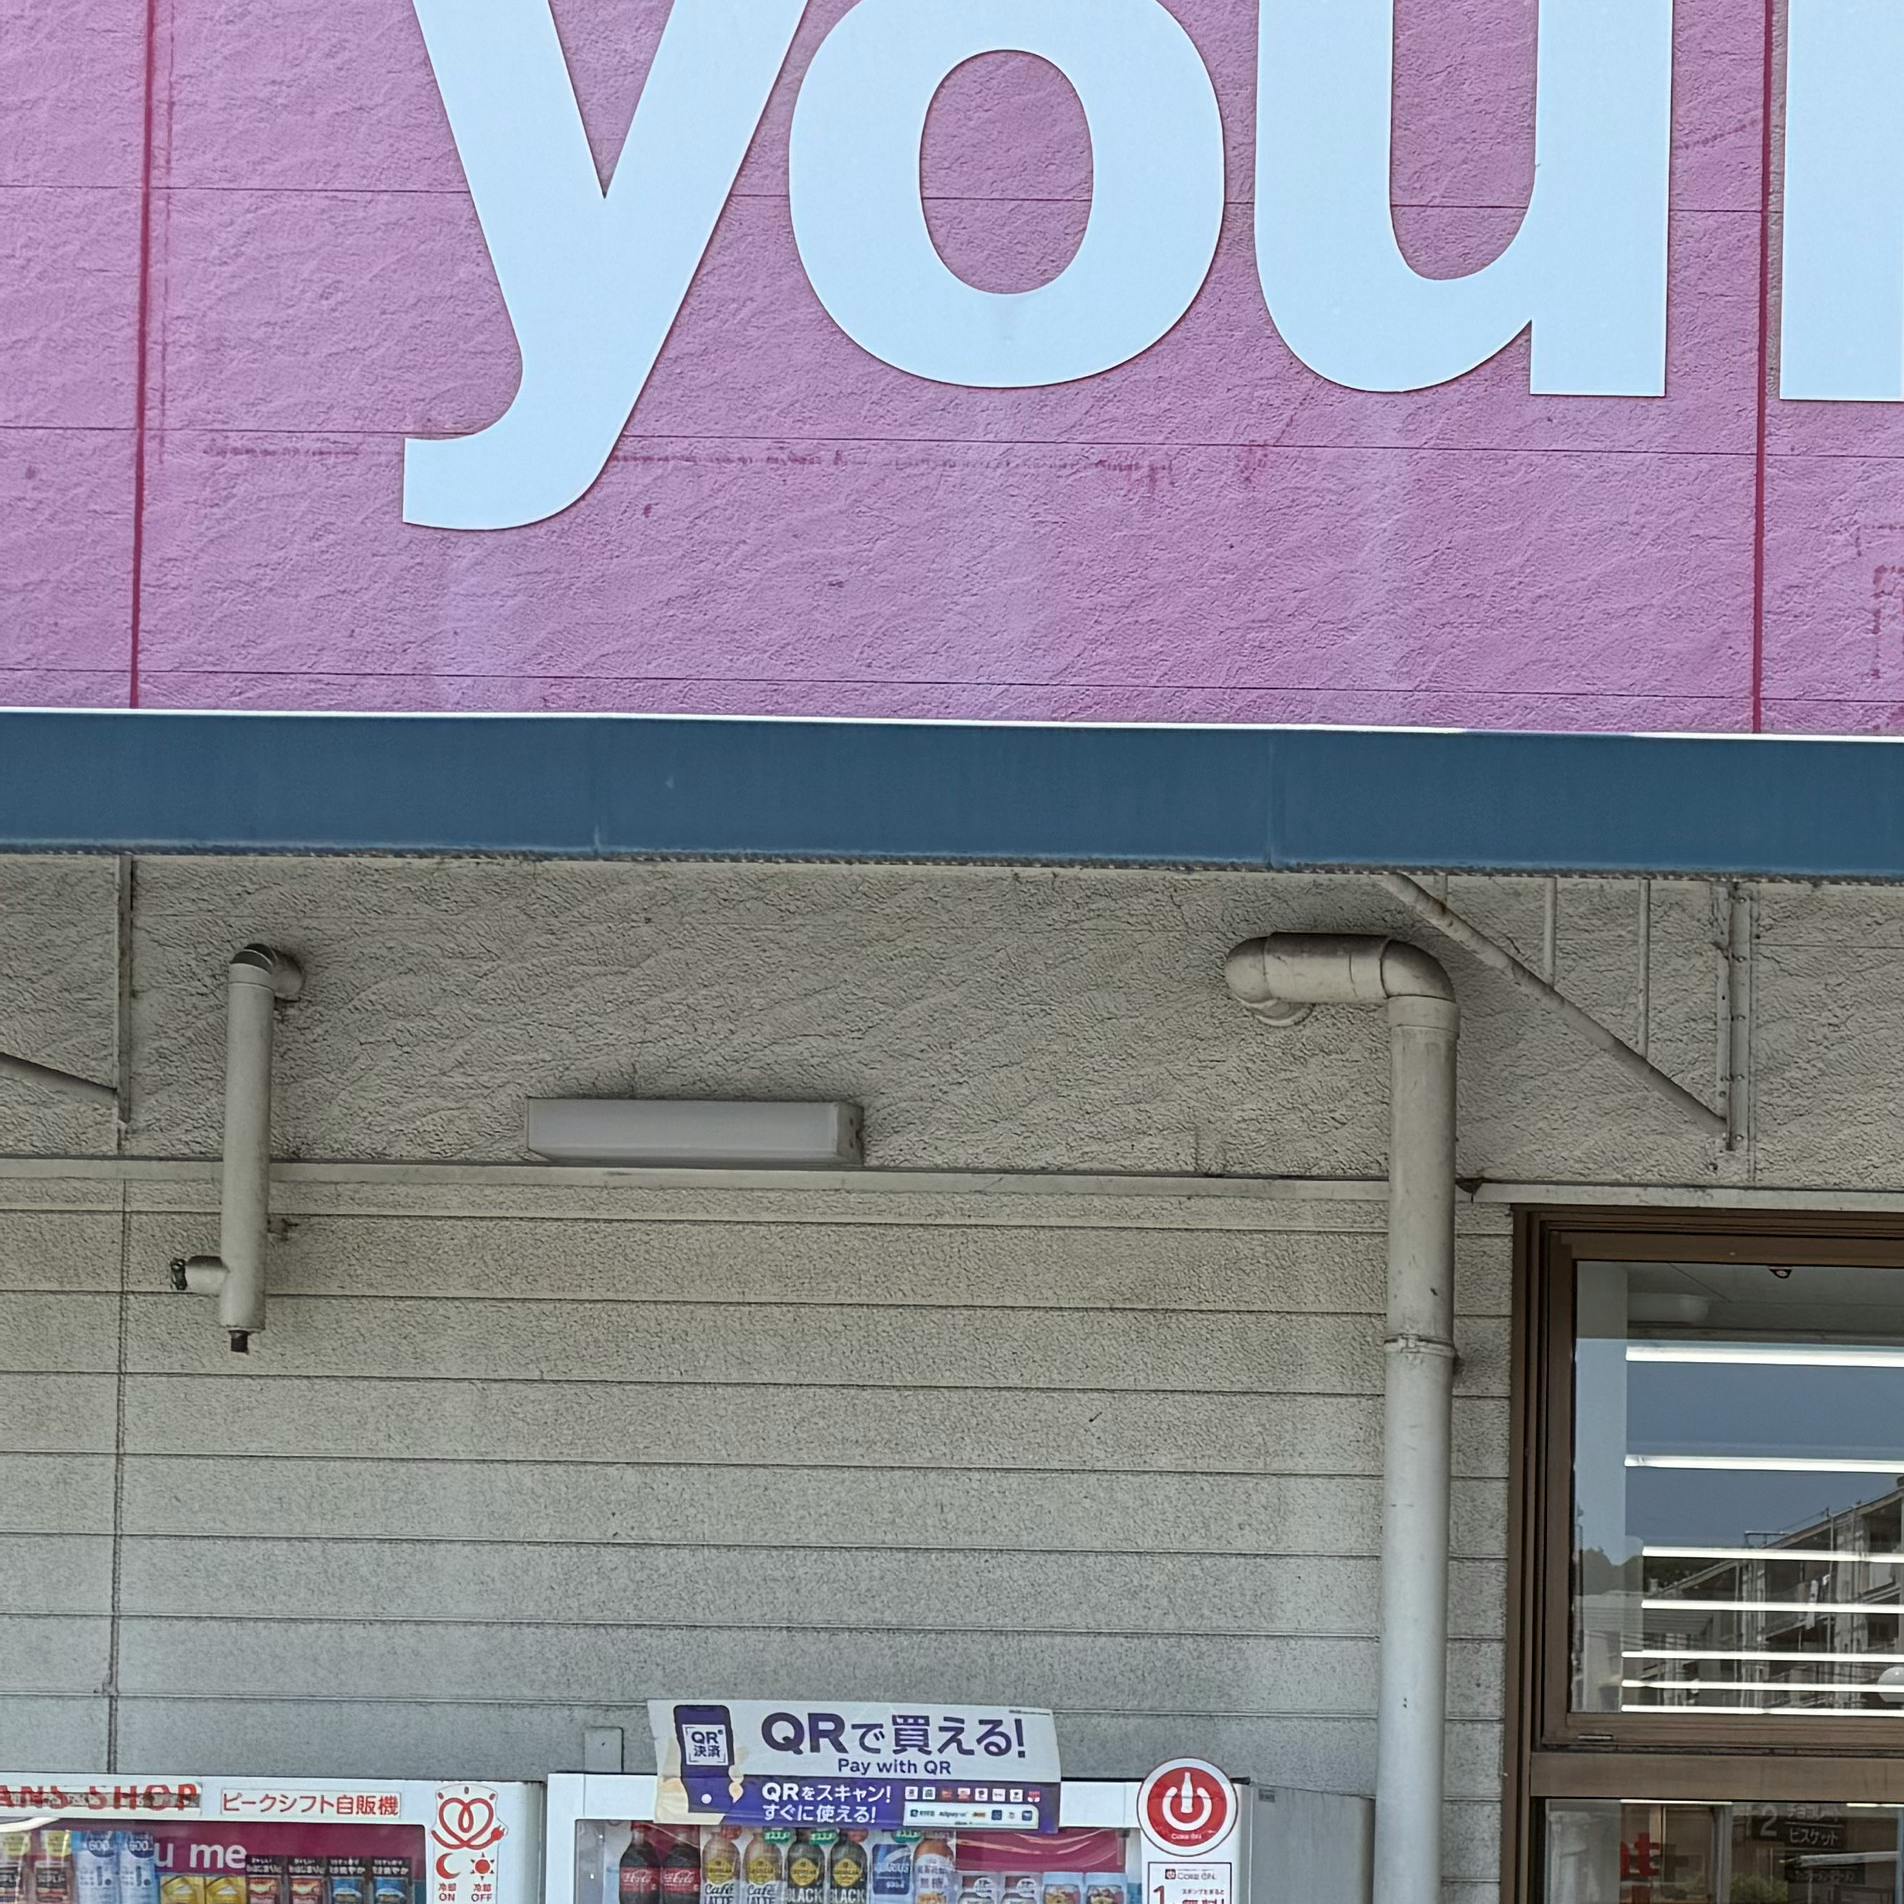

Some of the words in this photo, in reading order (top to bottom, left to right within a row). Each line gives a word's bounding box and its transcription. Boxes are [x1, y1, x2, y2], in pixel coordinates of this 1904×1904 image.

[761, 1711, 1027, 1759] QRで買える!
[692, 1744, 721, 1759] 決済
[838, 1757, 871, 1775] Pay
[876, 1757, 918, 1774] with
[923, 1760, 951, 1776] QR
[761, 1782, 893, 1803] QRをスキャン!
[222, 1793, 400, 1816] ピークシフト自販機
[761, 1804, 877, 1825] すぐに使える!
[471, 1893, 493, 1902] OFF
